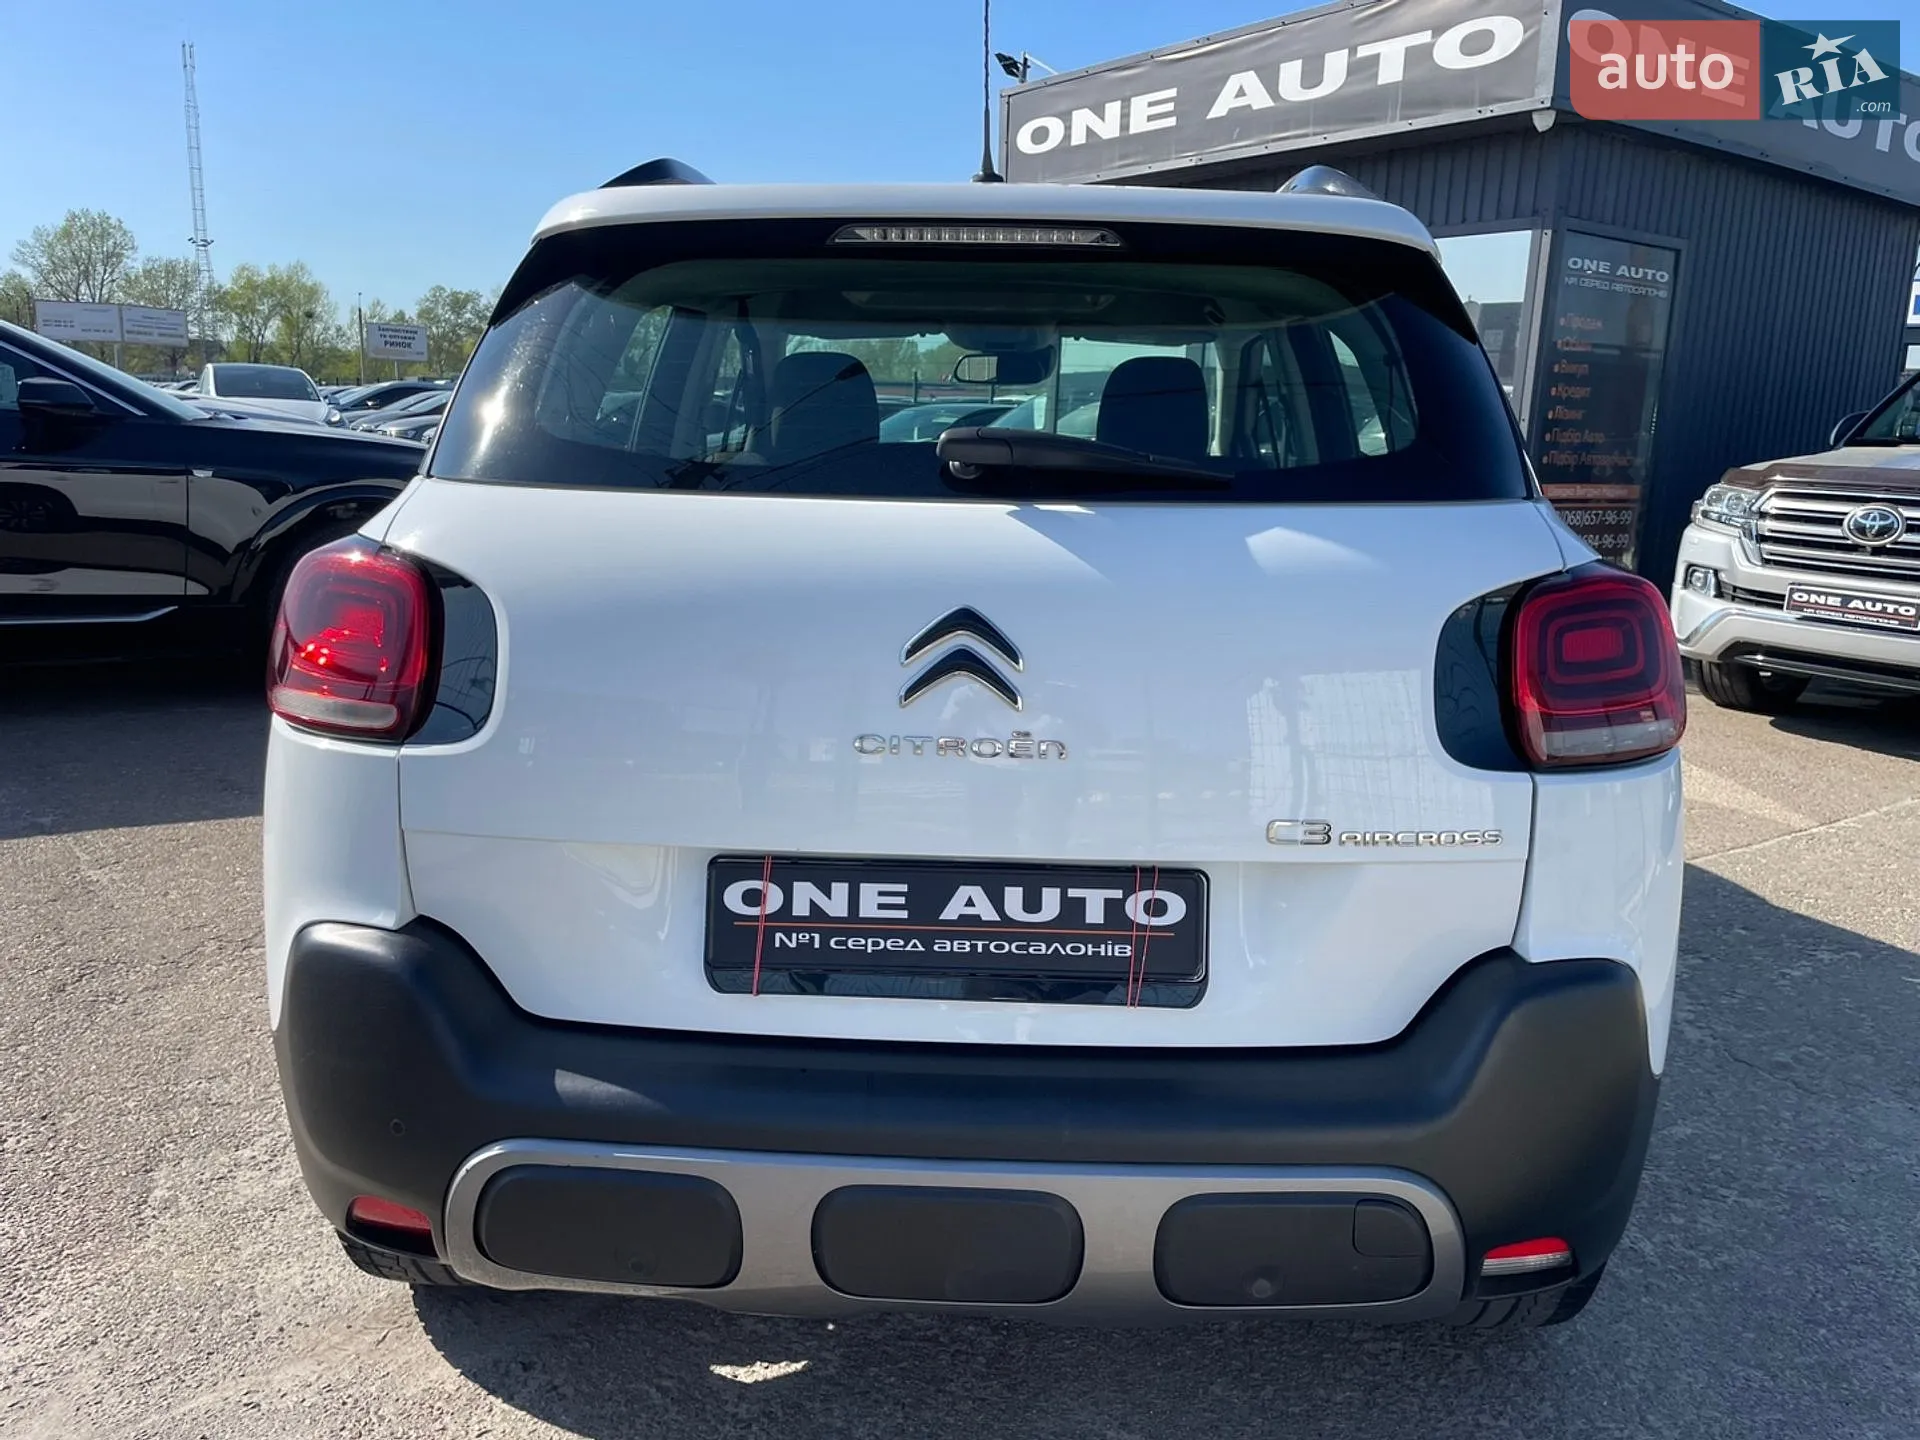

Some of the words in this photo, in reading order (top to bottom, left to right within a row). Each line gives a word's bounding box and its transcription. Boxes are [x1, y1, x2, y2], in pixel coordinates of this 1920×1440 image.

[1016, 87, 1178, 155] ONE
[1206, 14, 1525, 119] AUTO
[1568, 257, 1610, 273] ONE
[1616, 265, 1669, 283] AUTO
[384, 340, 413, 349] РИНОК
[1791, 591, 1842, 606] ONE
[1847, 599, 1916, 616] AUTO
[1266, 819, 1332, 845] C3
[1338, 829, 1502, 847] AIRCROSS
[723, 880, 908, 919] ONE
[938, 885, 1187, 926] AUTO
[774, 932, 820, 949] №1
[830, 935, 925, 954] серед
[933, 939, 1132, 957] автосалонів
